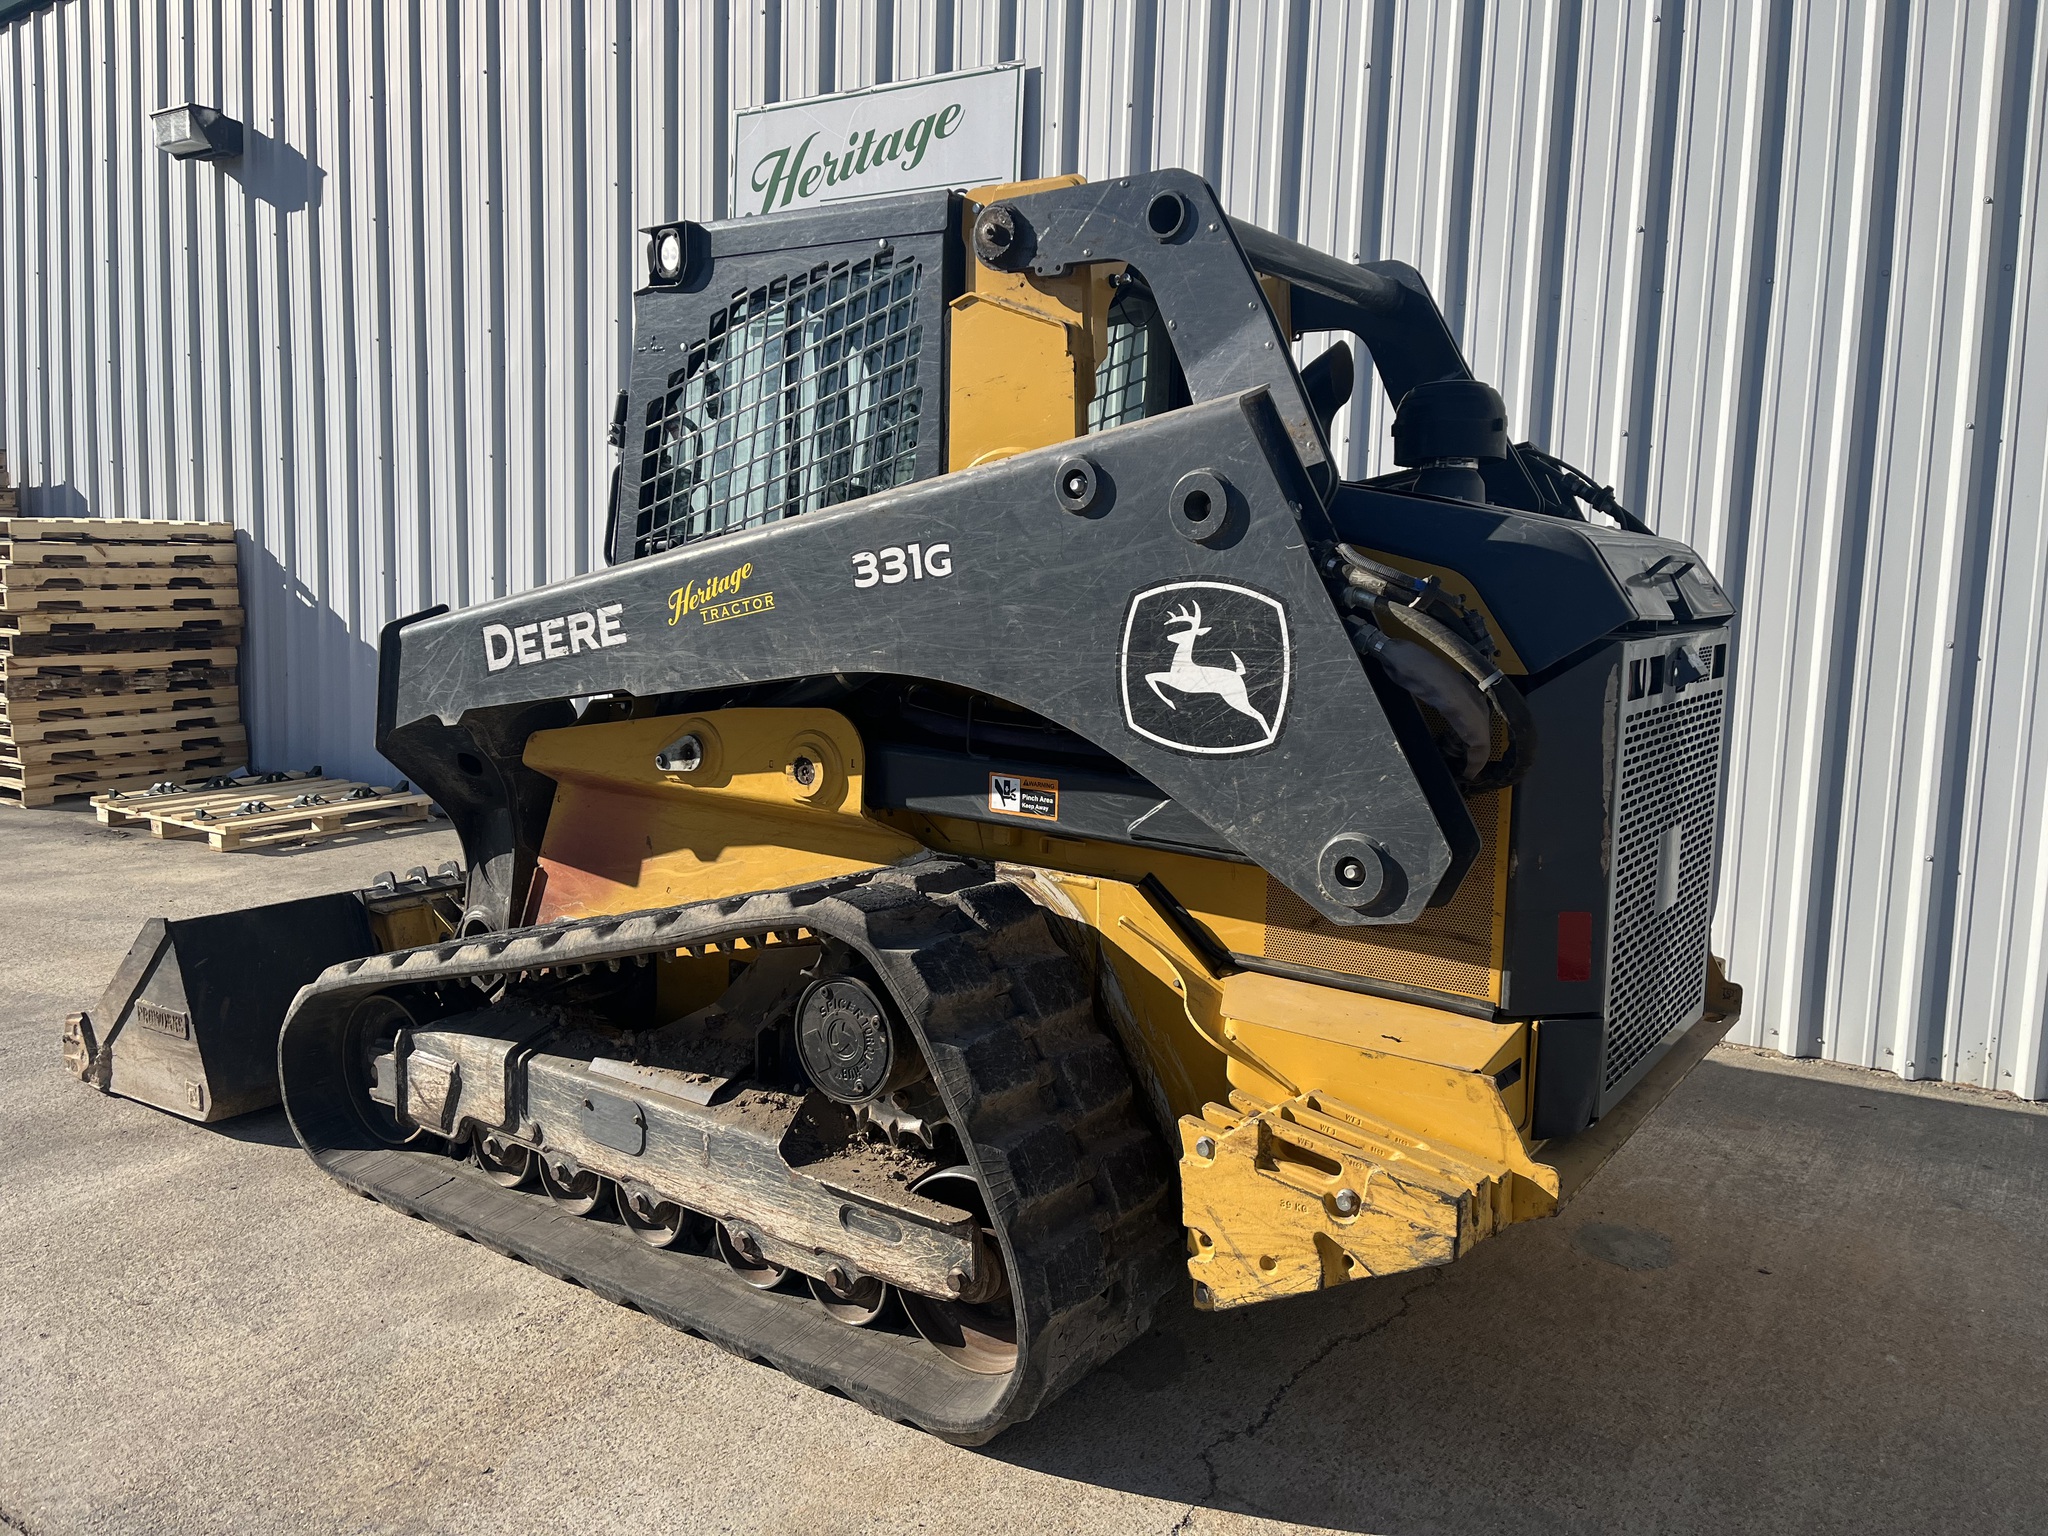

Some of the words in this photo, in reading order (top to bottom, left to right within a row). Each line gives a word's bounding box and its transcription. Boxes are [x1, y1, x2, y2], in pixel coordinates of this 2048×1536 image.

[749, 103, 966, 217] Heritage
[852, 543, 952, 588] 331G
[668, 563, 753, 626] Heritage
[700, 595, 775, 621] TRACTOR
[482, 603, 627, 671] DEERE
[1022, 793, 1039, 802] Pinch
[1039, 796, 1054, 804] Area
[1028, 781, 1055, 790] WARNING
[1021, 803, 1035, 811] Keep
[1035, 804, 1049, 812] Away
[820, 998, 864, 1020] SPICER
